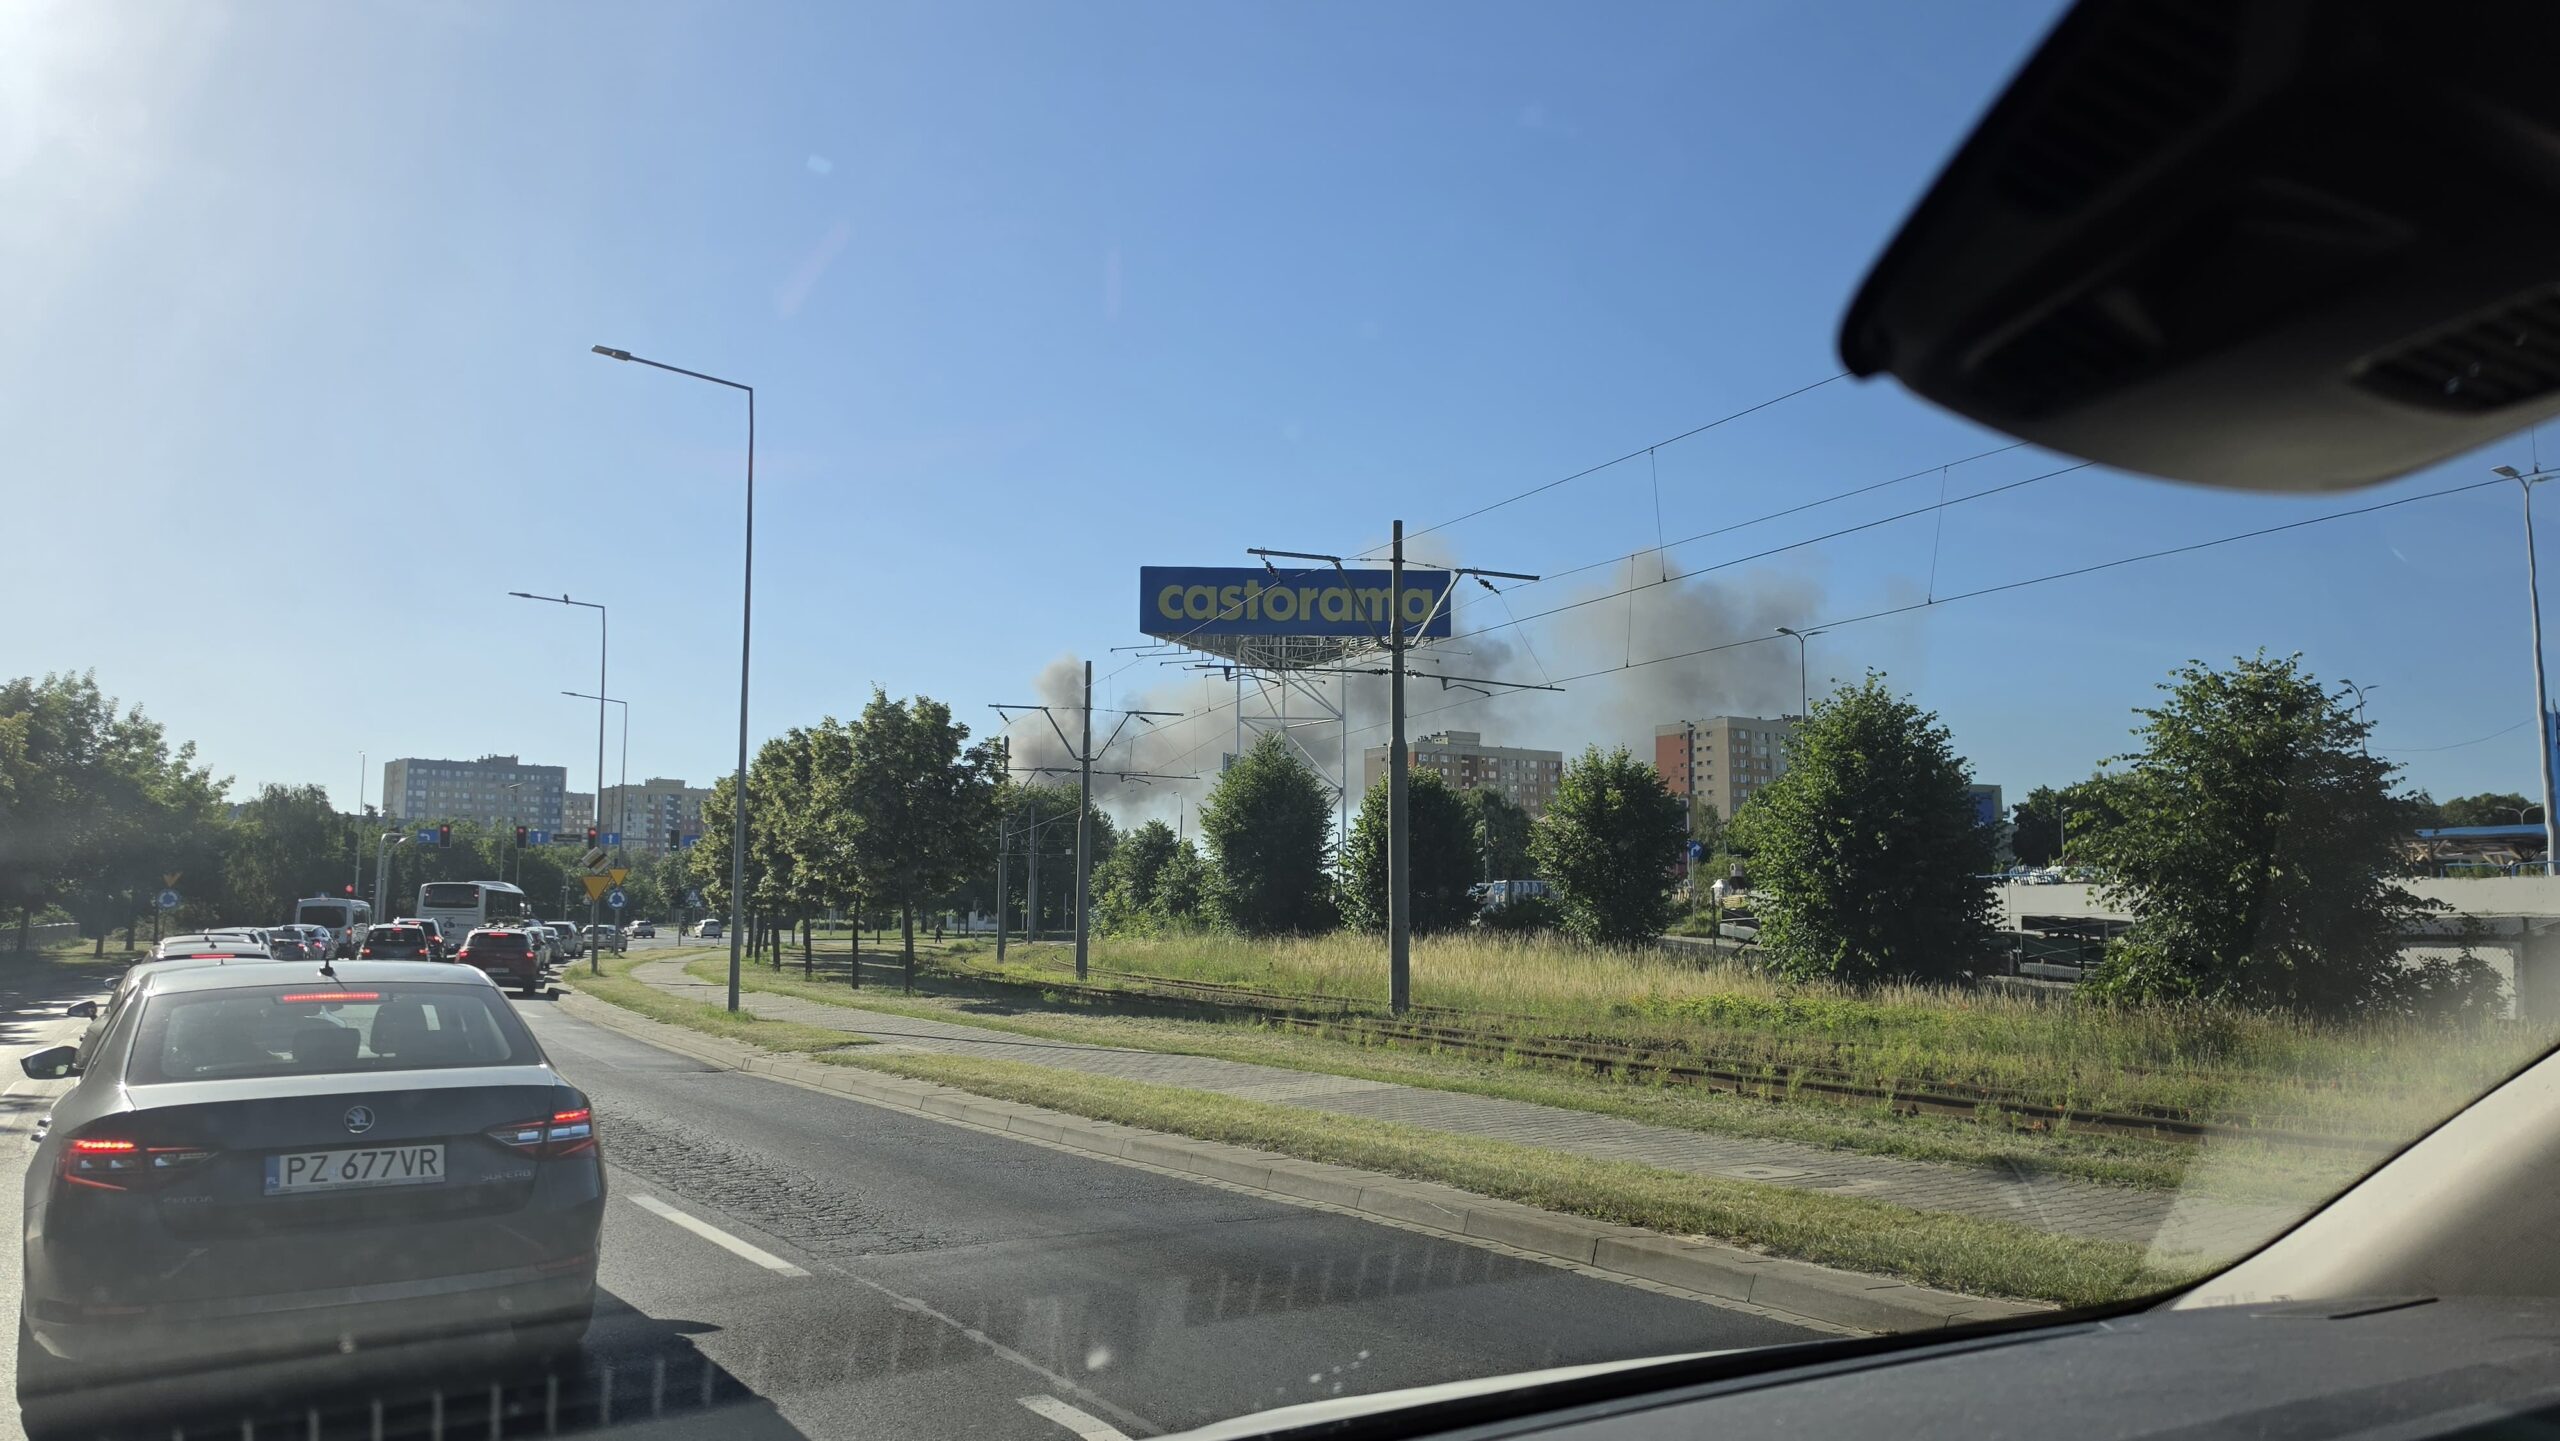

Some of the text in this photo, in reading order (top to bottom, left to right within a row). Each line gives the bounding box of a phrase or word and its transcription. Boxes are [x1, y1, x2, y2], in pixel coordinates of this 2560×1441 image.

[1158, 579, 1433, 622] castorama
[266, 1176, 279, 1185] PL
[287, 1154, 329, 1185] PZ
[341, 1148, 438, 1180] 677VR
